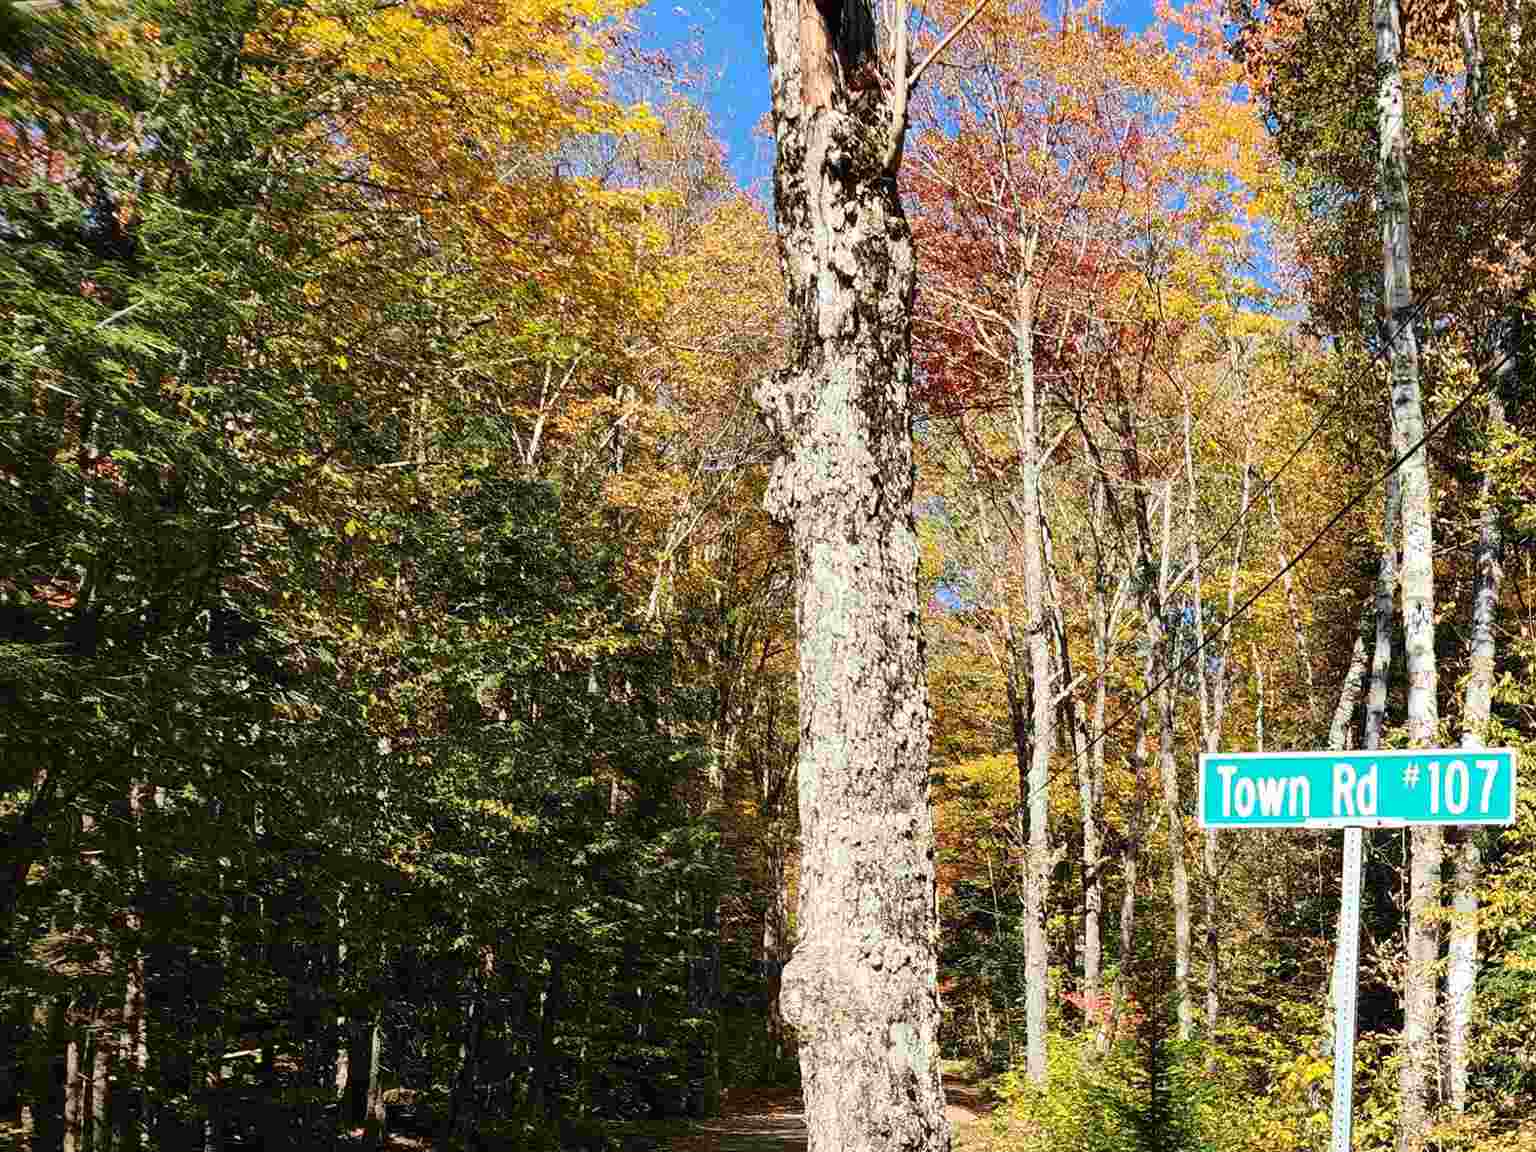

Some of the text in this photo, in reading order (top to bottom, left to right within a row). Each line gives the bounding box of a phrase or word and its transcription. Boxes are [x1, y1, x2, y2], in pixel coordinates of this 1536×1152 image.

[1217, 759, 1499, 817] Town Rd #107
